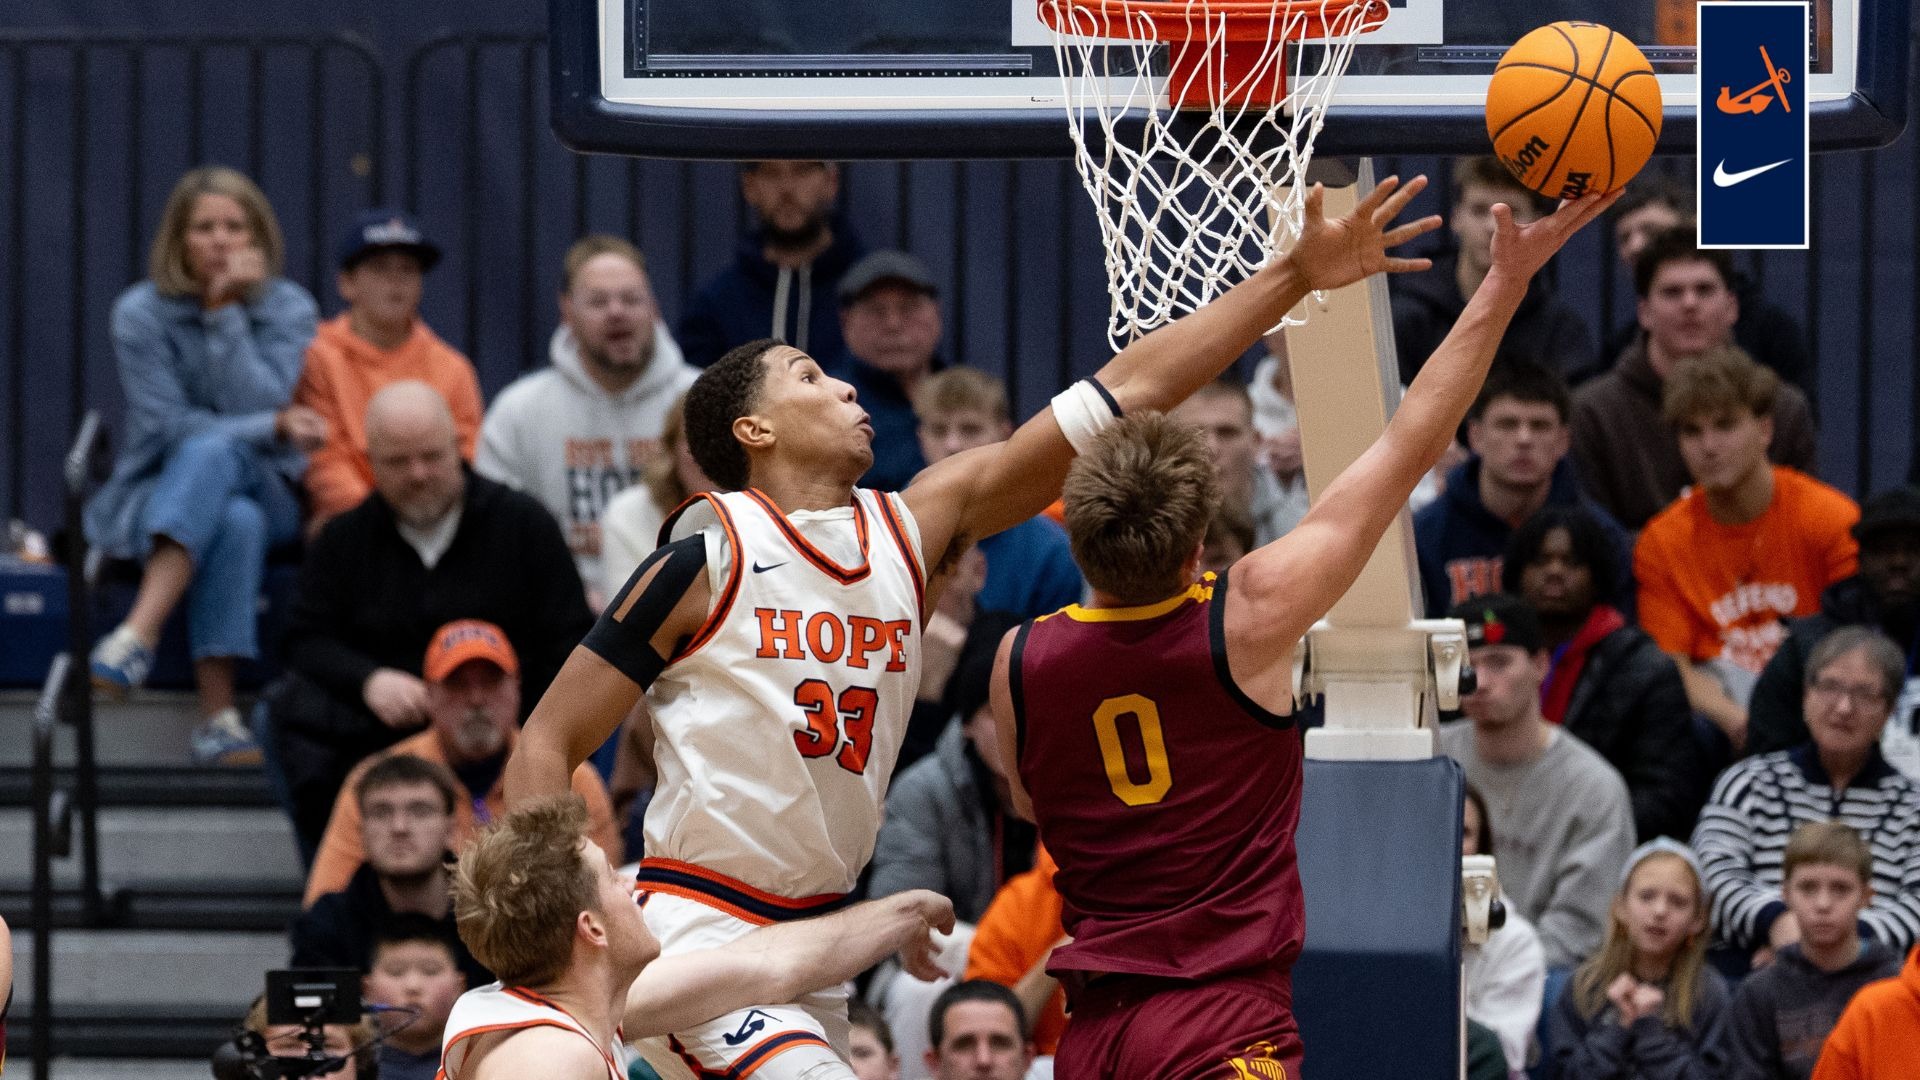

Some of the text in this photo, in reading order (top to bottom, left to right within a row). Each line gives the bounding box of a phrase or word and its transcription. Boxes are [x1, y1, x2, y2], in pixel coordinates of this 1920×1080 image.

[755, 607, 911, 672] HOPE
[793, 678, 879, 775] 33
[1092, 692, 1172, 806] 0
